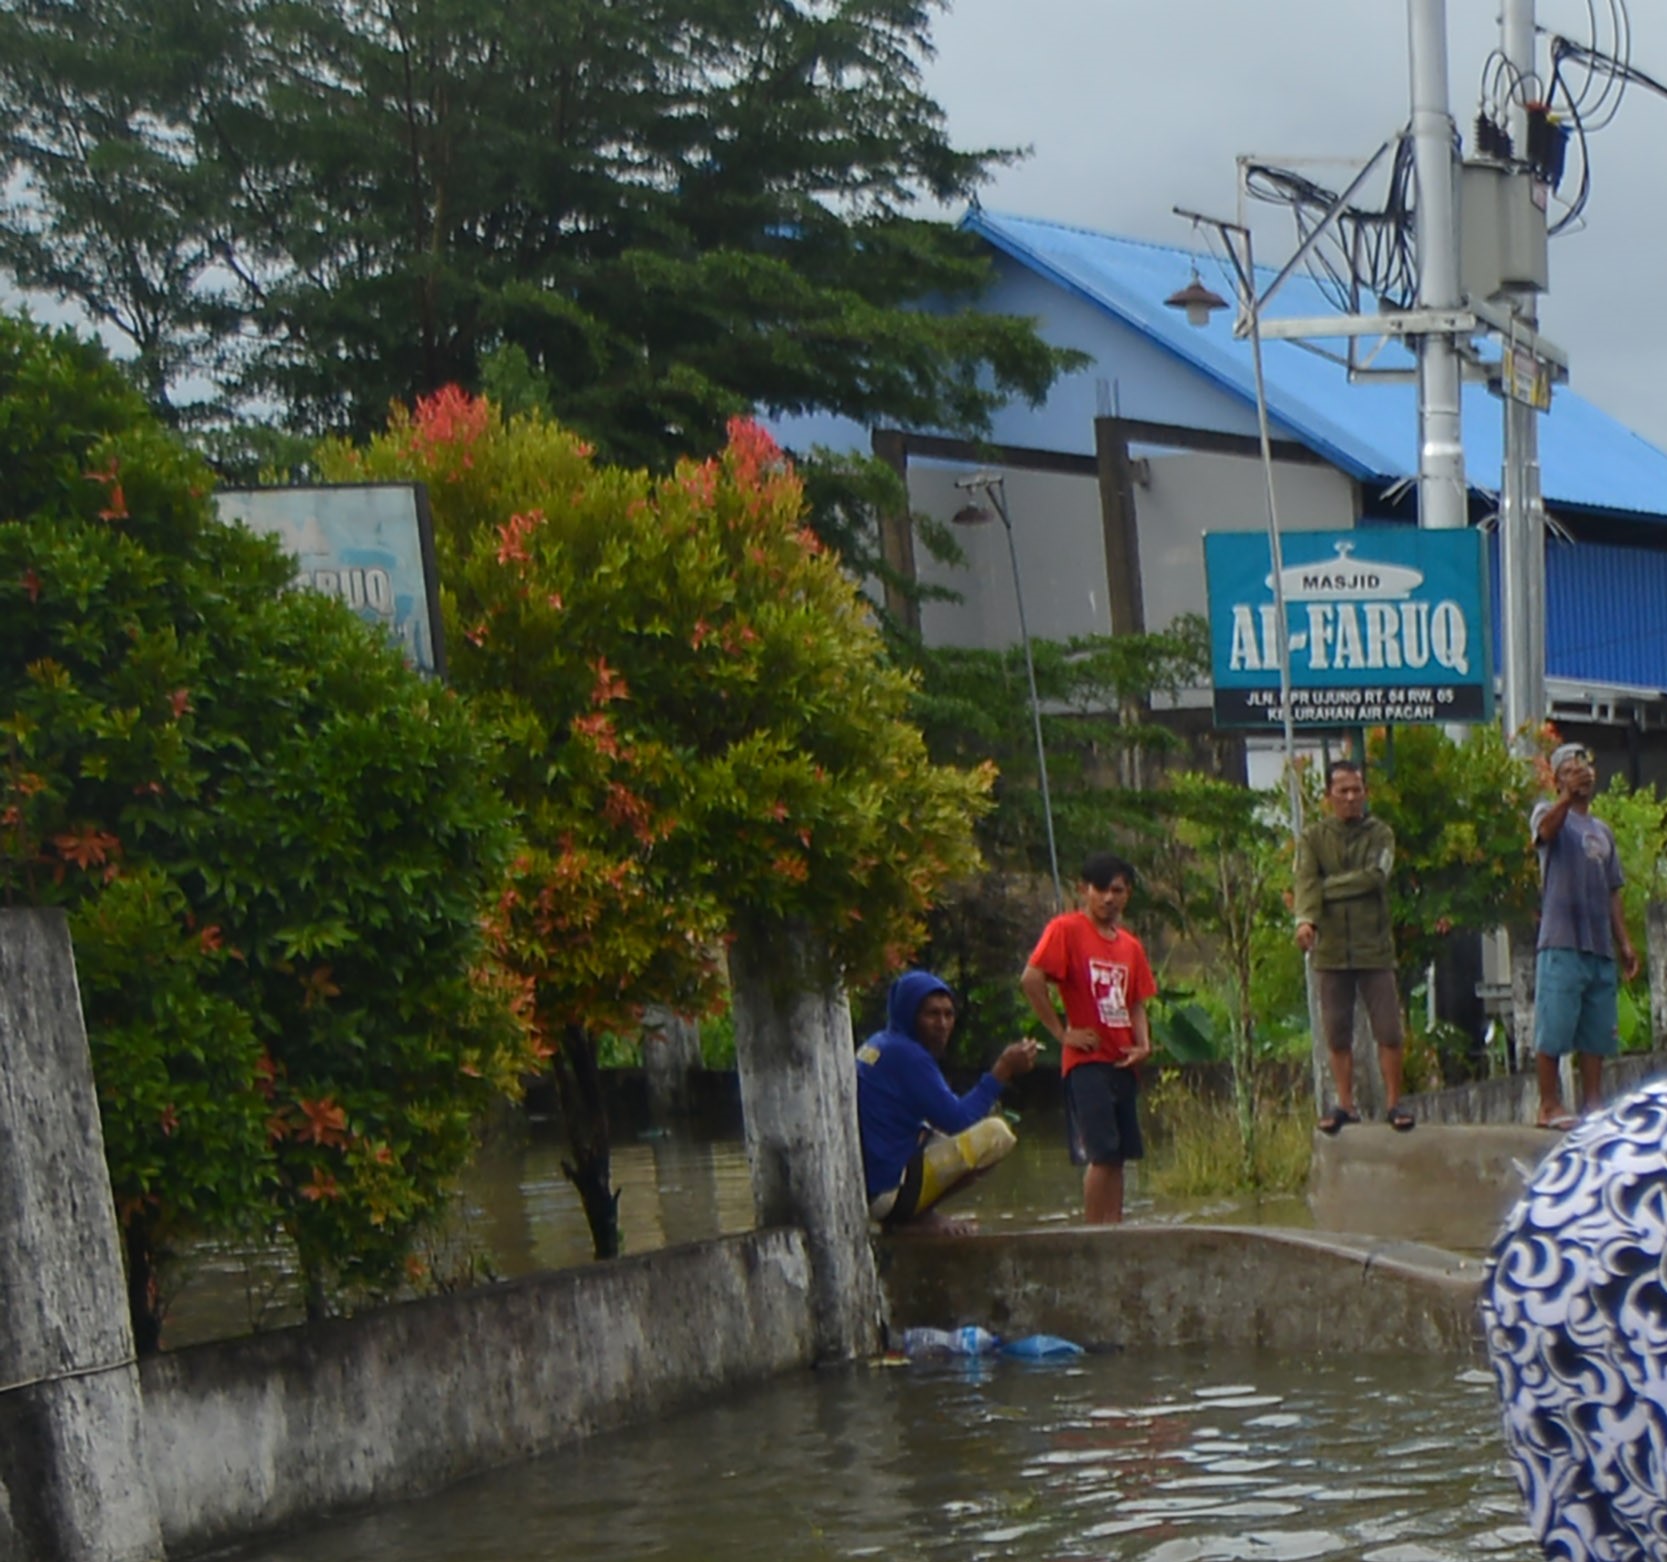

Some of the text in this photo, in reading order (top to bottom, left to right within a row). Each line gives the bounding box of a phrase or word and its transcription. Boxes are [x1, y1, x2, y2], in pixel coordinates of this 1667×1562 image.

[1302, 574, 1381, 591] MASJID
[1312, 688, 1361, 705] UJUNG
[1364, 688, 1386, 704] RT.
[1358, 705, 1382, 720] AIR
